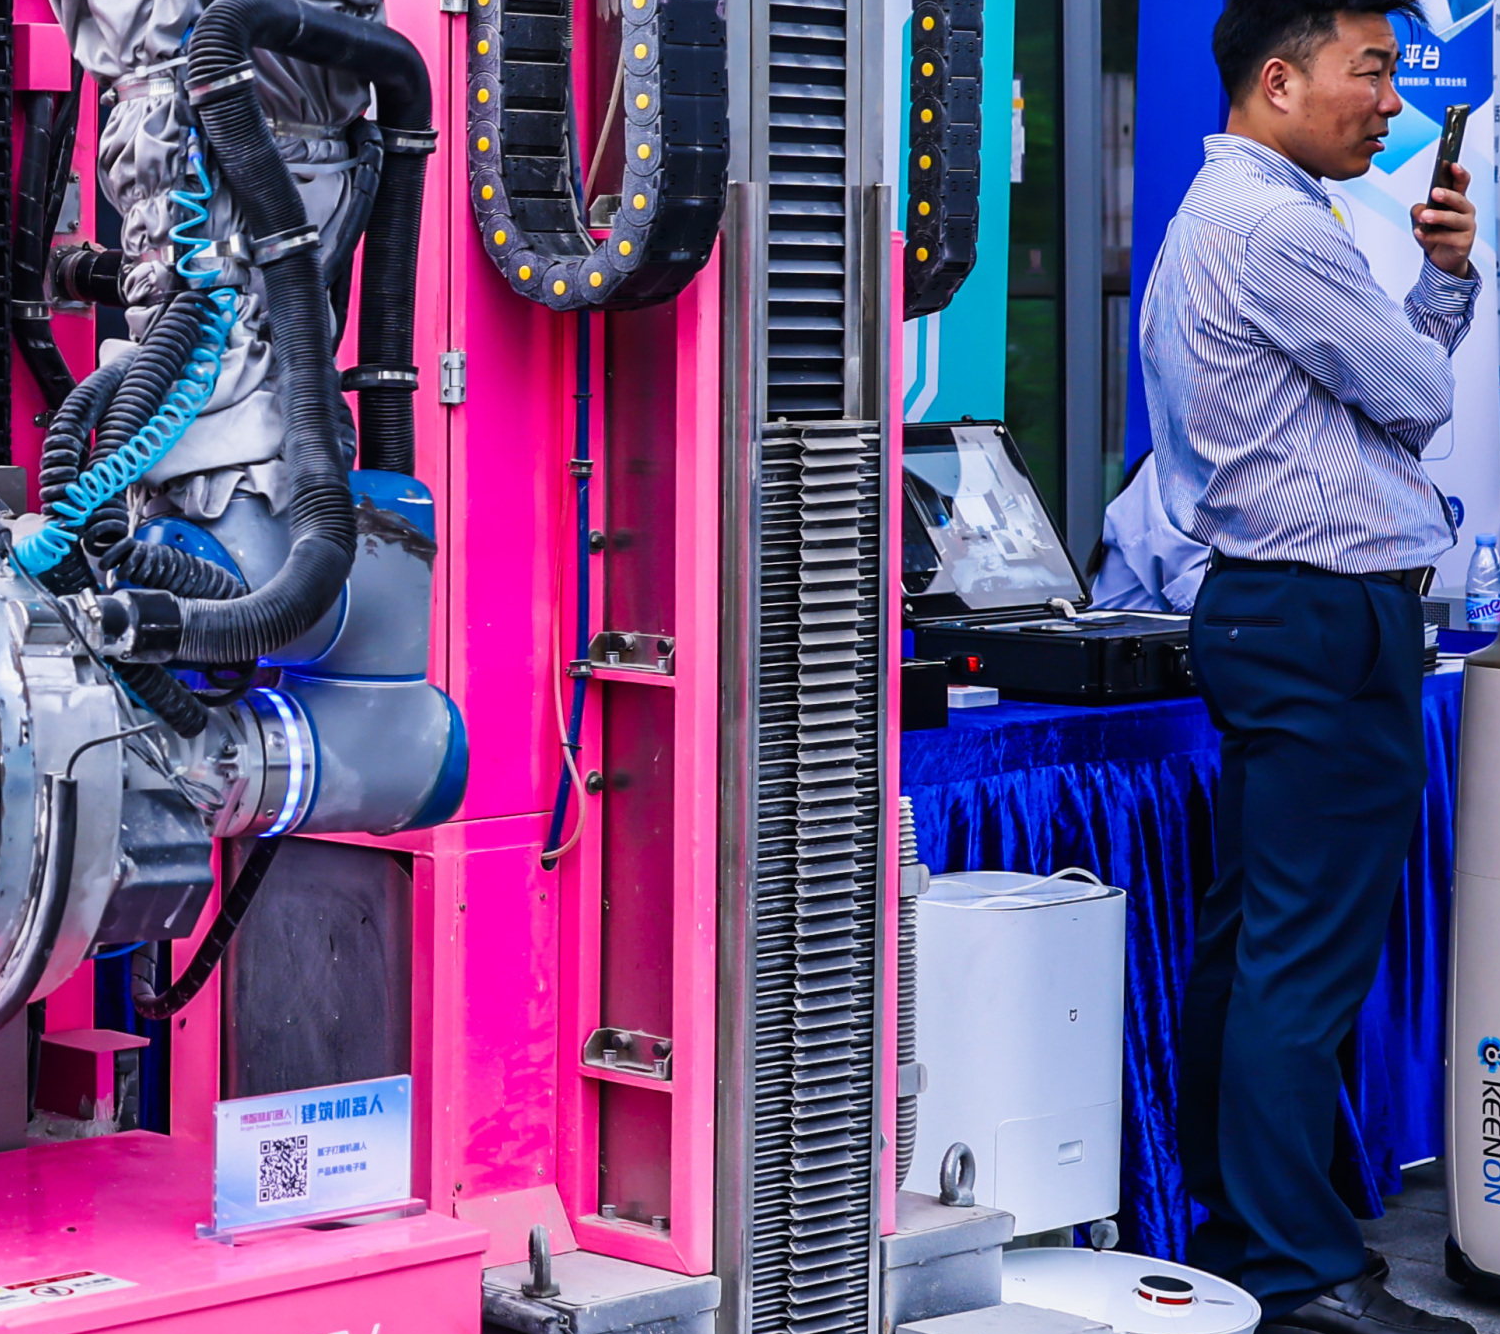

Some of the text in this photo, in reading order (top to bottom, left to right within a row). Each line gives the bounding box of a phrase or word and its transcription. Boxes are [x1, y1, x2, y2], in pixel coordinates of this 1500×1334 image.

[1404, 44, 1440, 69] 平台
[301, 1093, 385, 1125] 建筑机器人
